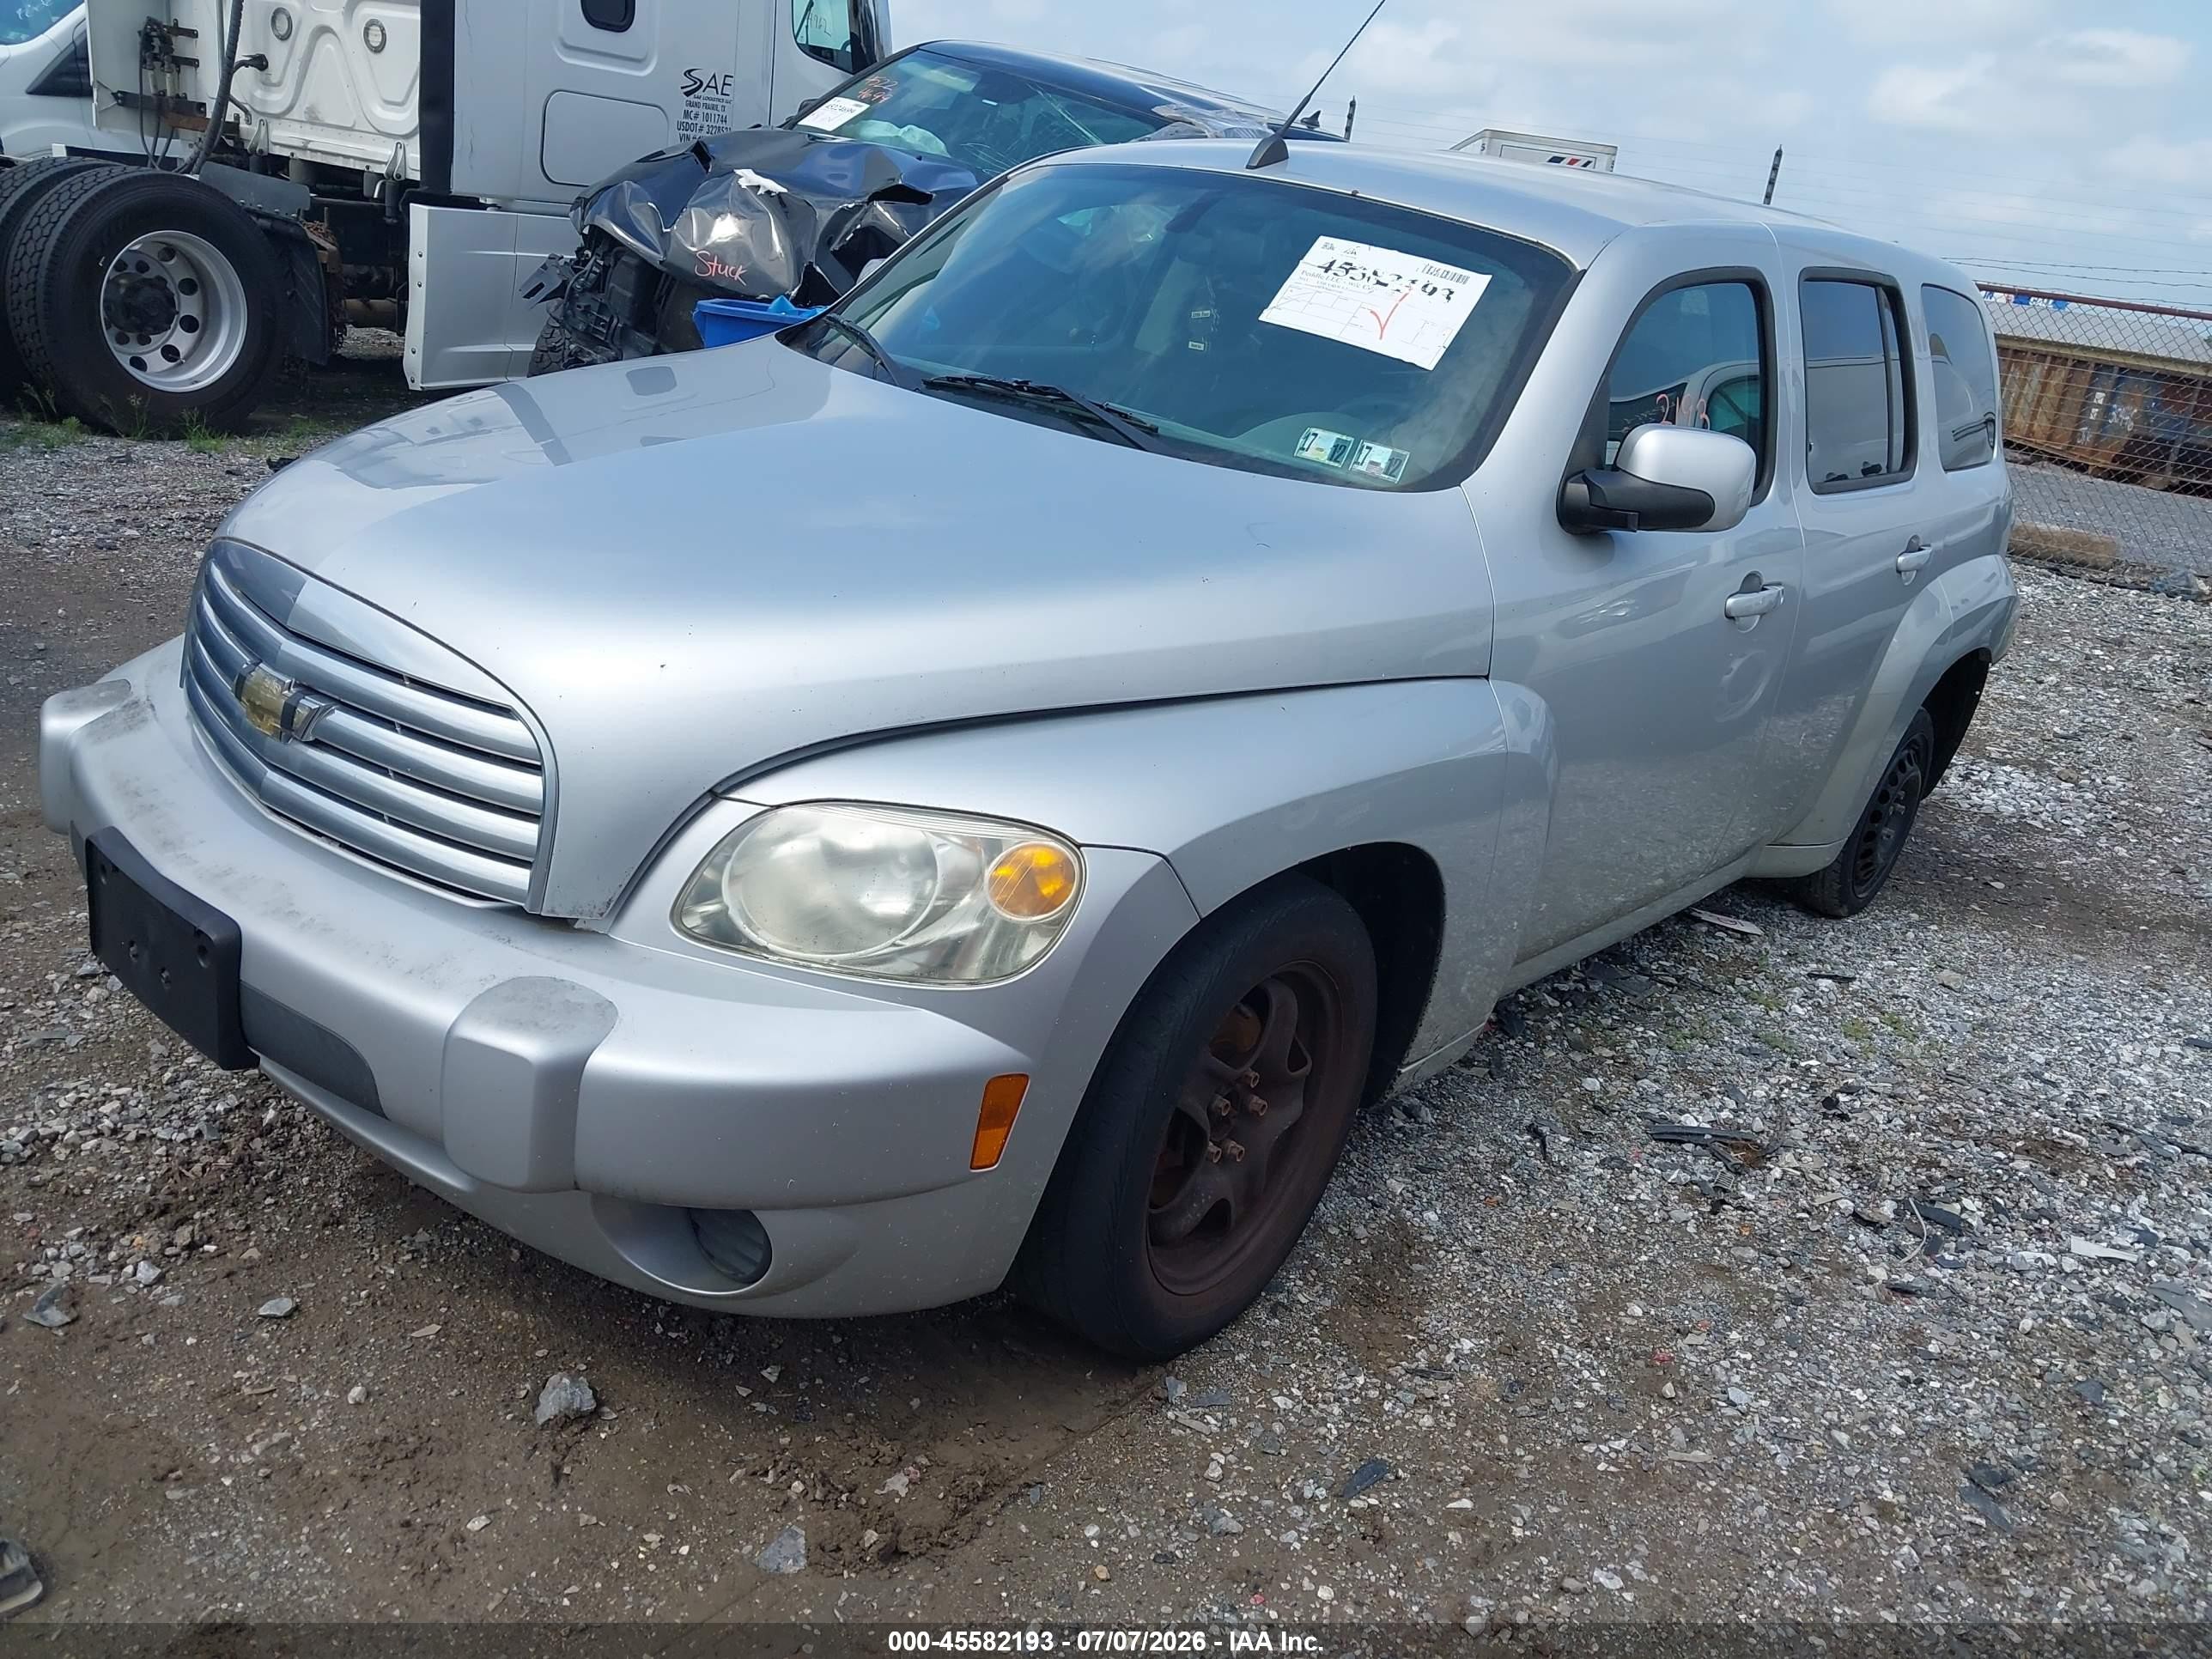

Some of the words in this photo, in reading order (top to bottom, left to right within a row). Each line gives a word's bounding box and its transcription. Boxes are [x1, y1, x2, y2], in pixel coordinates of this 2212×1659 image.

[681, 68, 733, 97] SAE
[685, 100, 702, 108] GRAND
[684, 109, 700, 121] MC#
[702, 112, 727, 125] 1011744
[677, 120, 704, 134] USDOT#
[679, 132, 691, 143] VIN
[695, 250, 748, 286] Stuck
